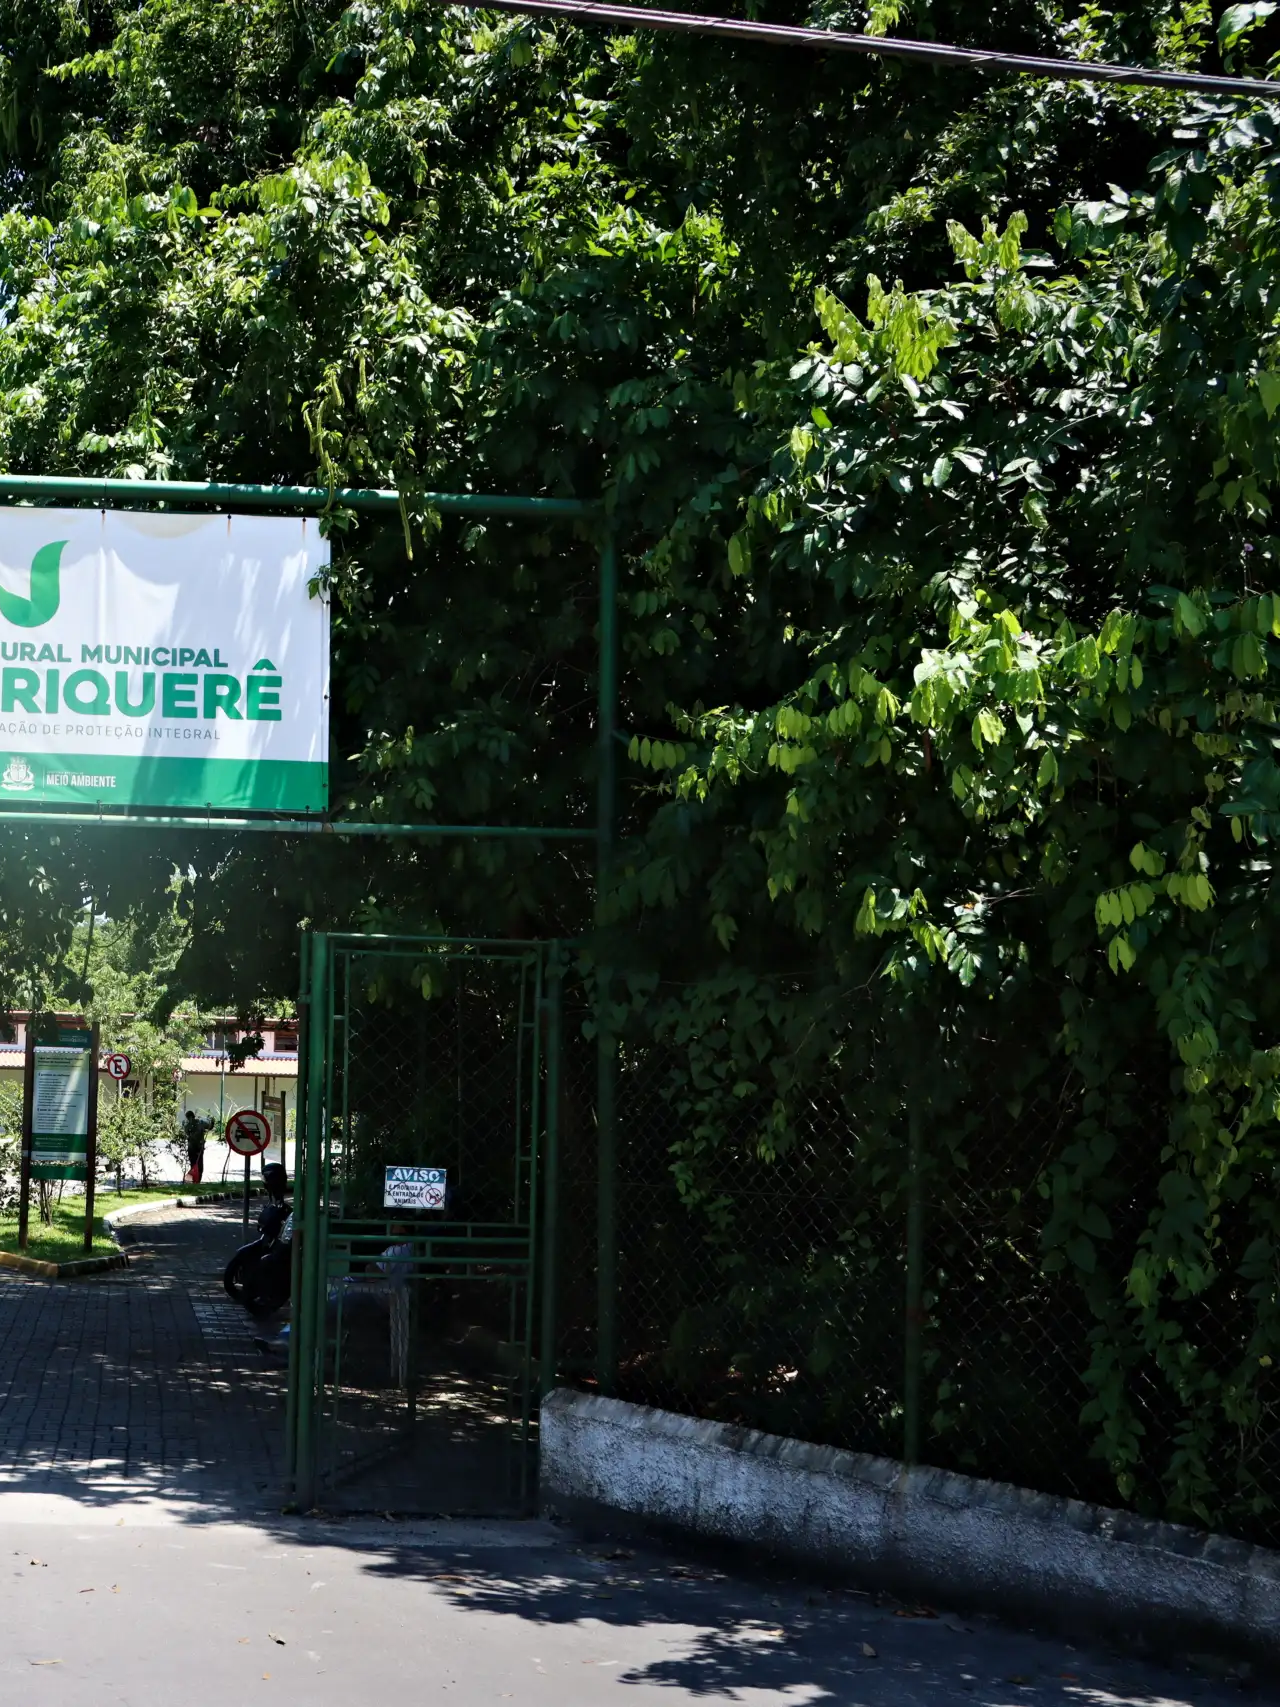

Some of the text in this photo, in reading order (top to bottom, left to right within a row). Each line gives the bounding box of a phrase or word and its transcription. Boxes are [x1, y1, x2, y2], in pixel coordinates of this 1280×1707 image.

[81, 643, 228, 668] MUNICIPAL
[42, 723, 61, 735] DE
[65, 723, 144, 738] PROTEÇÃO
[148, 728, 220, 740] INTEGRAL
[46, 774, 117, 788] MEIO AMBIENTE
